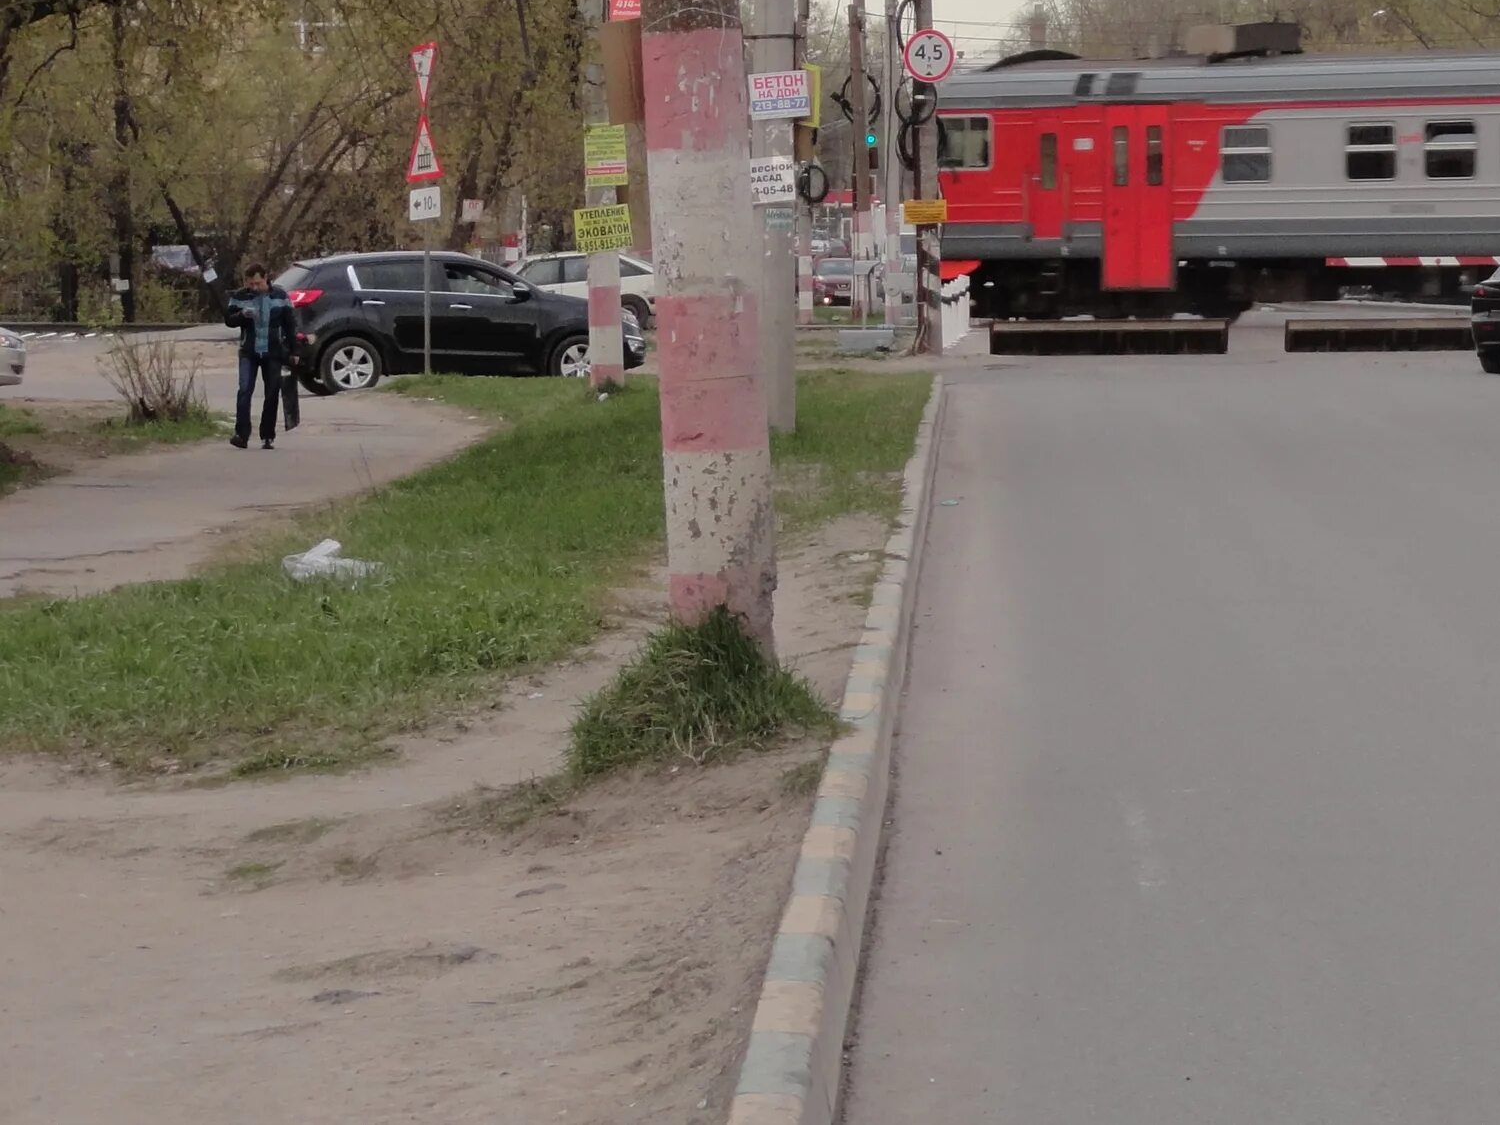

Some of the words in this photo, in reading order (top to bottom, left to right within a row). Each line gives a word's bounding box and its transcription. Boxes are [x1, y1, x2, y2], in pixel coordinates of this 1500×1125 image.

[914, 44, 943, 62] 4,5
[753, 74, 804, 90] БЕТОН
[759, 89, 773, 98] НА
[776, 88, 801, 99] ДОМ
[754, 98, 807, 111] 213-88-77
[424, 196, 432, 210] 10
[579, 207, 625, 220] УТЕПЛЕНИЕ
